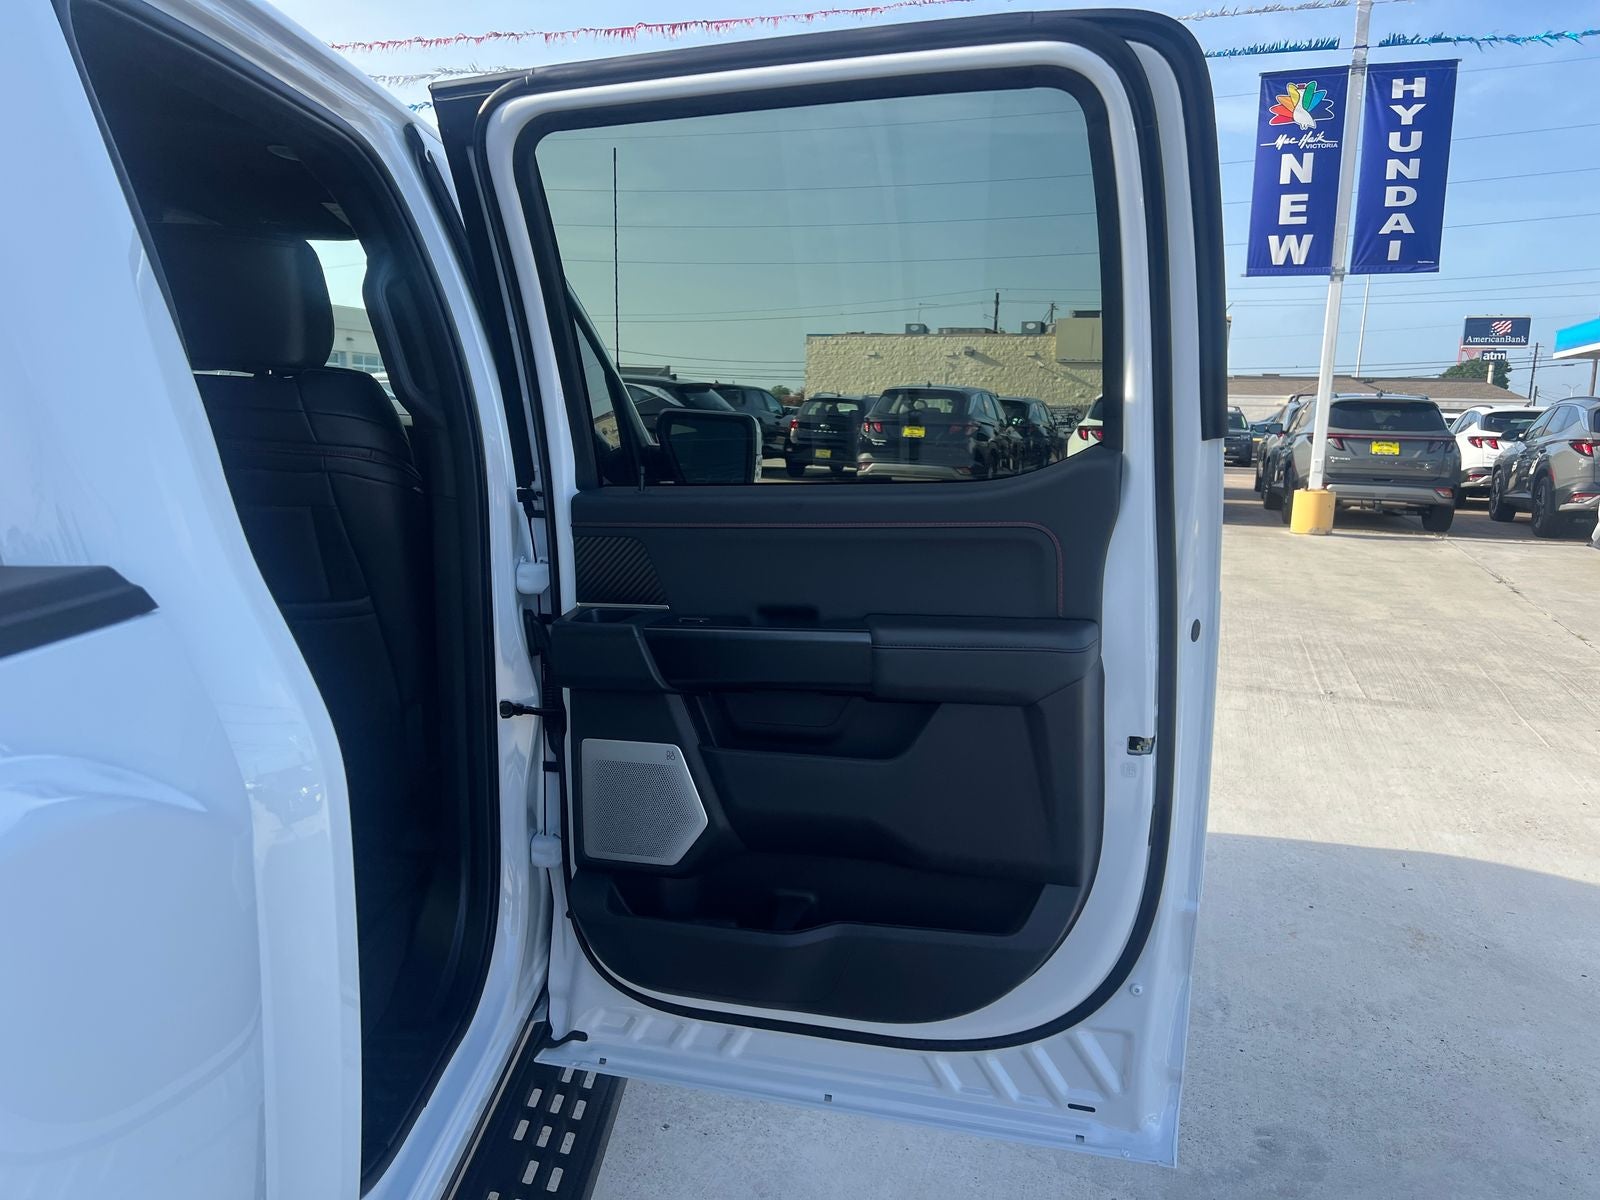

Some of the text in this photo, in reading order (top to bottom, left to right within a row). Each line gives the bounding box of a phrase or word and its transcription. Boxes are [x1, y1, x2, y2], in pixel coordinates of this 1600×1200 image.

[1274, 131, 1326, 150] Mac Haik
[1378, 77, 1426, 261] HYUNDAI
[1268, 152, 1315, 266] NEW
[1482, 352, 1506, 360] atm
